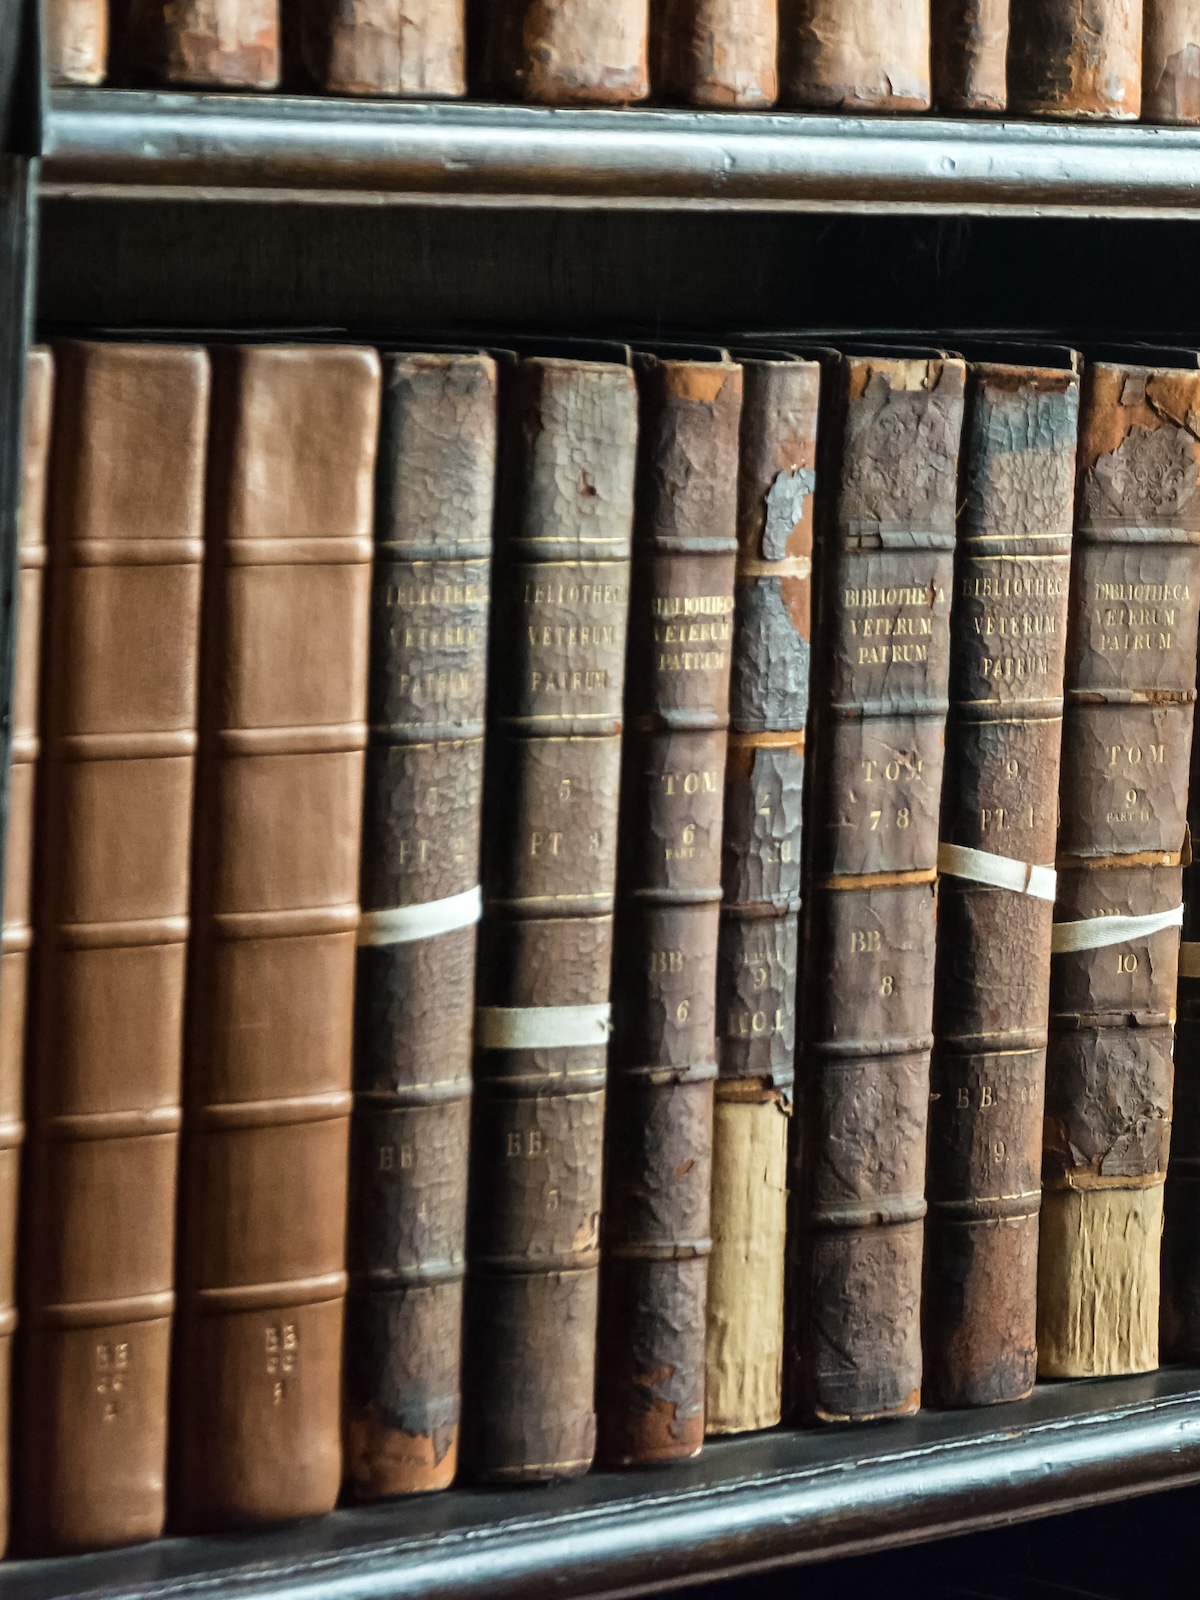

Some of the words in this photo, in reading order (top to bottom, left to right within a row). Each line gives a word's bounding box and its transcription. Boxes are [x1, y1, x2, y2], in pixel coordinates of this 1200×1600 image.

[844, 587, 945, 608] BIBLIOTHEA
[1095, 583, 1190, 601] BIBLIOTHECA
[850, 617, 933, 637] VETERUM
[974, 613, 1055, 635] VETERUM
[1096, 608, 1176, 626] VETERUM
[528, 626, 615, 646] VETERUM
[1101, 632, 1172, 650] PATRUM
[858, 644, 928, 665] PATRUM
[983, 655, 1049, 677] PATRUM
[531, 671, 608, 692] PATRUM
[1106, 744, 1165, 766] TOM
[1006, 759, 1019, 779] 9
[1125, 789, 1138, 809] 9
[1106, 811, 1135, 823] PART
[531, 831, 563, 856] PT
[682, 823, 696, 845] 6
[676, 999, 690, 1022] 6
